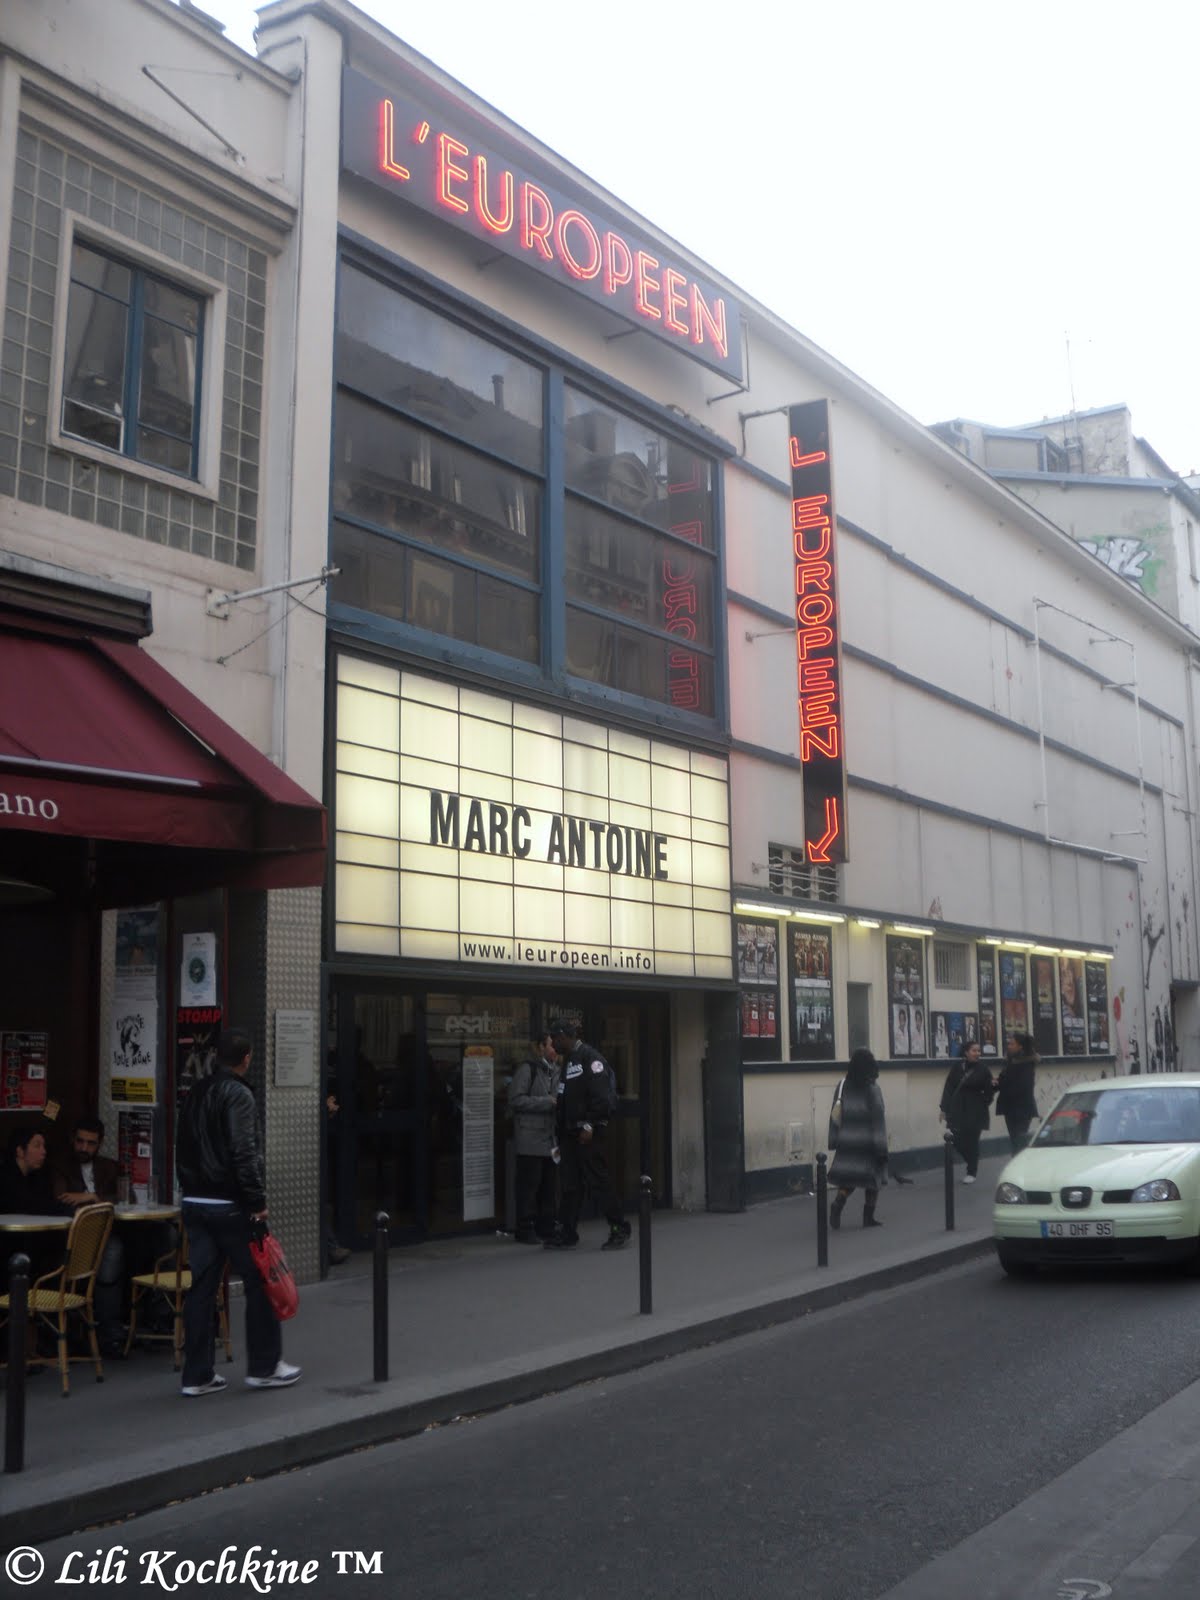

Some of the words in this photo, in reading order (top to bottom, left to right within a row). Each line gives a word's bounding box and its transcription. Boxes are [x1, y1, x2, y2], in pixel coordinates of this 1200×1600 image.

[378, 98, 729, 358] L'EUROPEEN
[430, 789, 532, 859] MARC
[547, 813, 669, 880] ANTOINE
[463, 942, 652, 971] www.leuropeen.info
[178, 1008, 222, 1024] STOMP
[1096, 1223, 1111, 1235] 95
